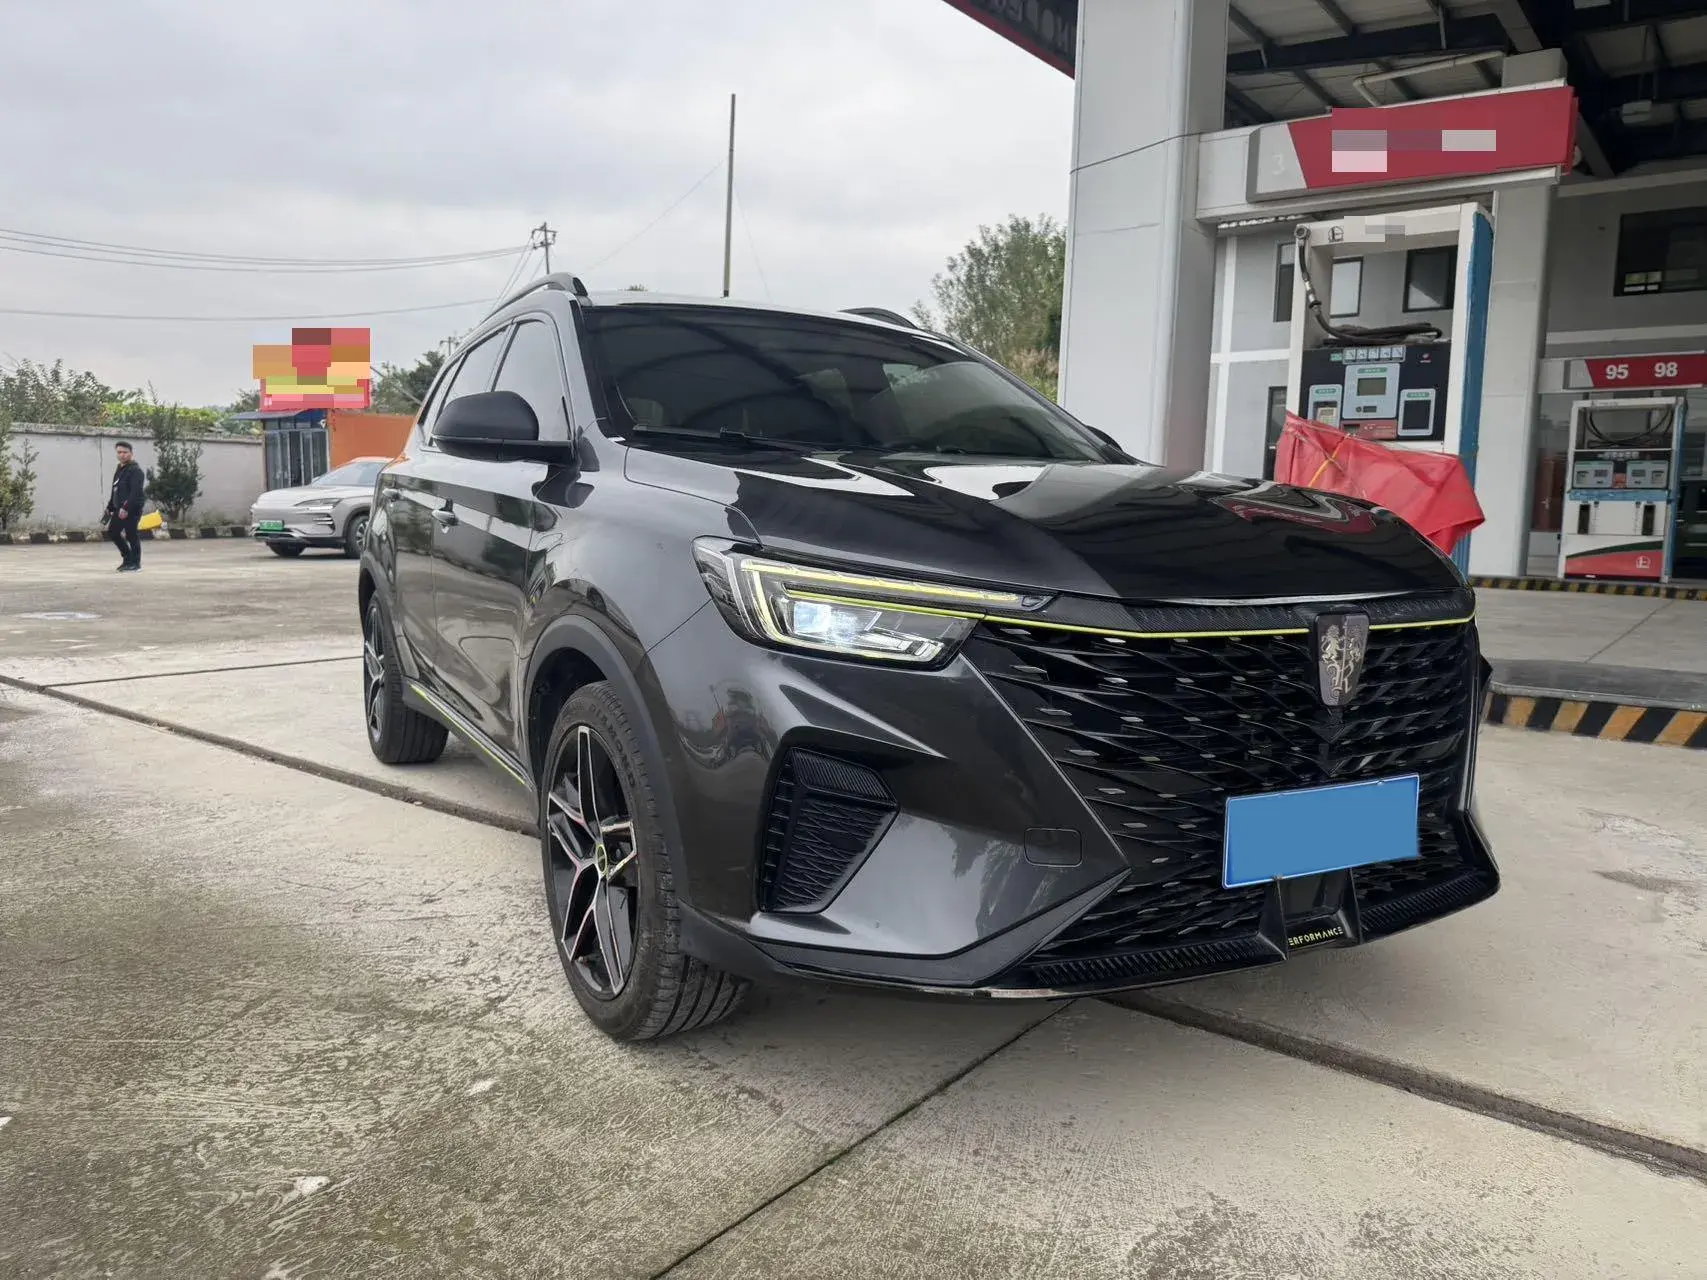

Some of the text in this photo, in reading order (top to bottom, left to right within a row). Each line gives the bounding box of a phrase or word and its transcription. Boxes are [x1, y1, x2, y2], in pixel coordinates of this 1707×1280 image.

[1272, 153, 1285, 175] 3
[1606, 361, 1678, 380] 95 98
[1288, 926, 1344, 946] ERFORMANCE
